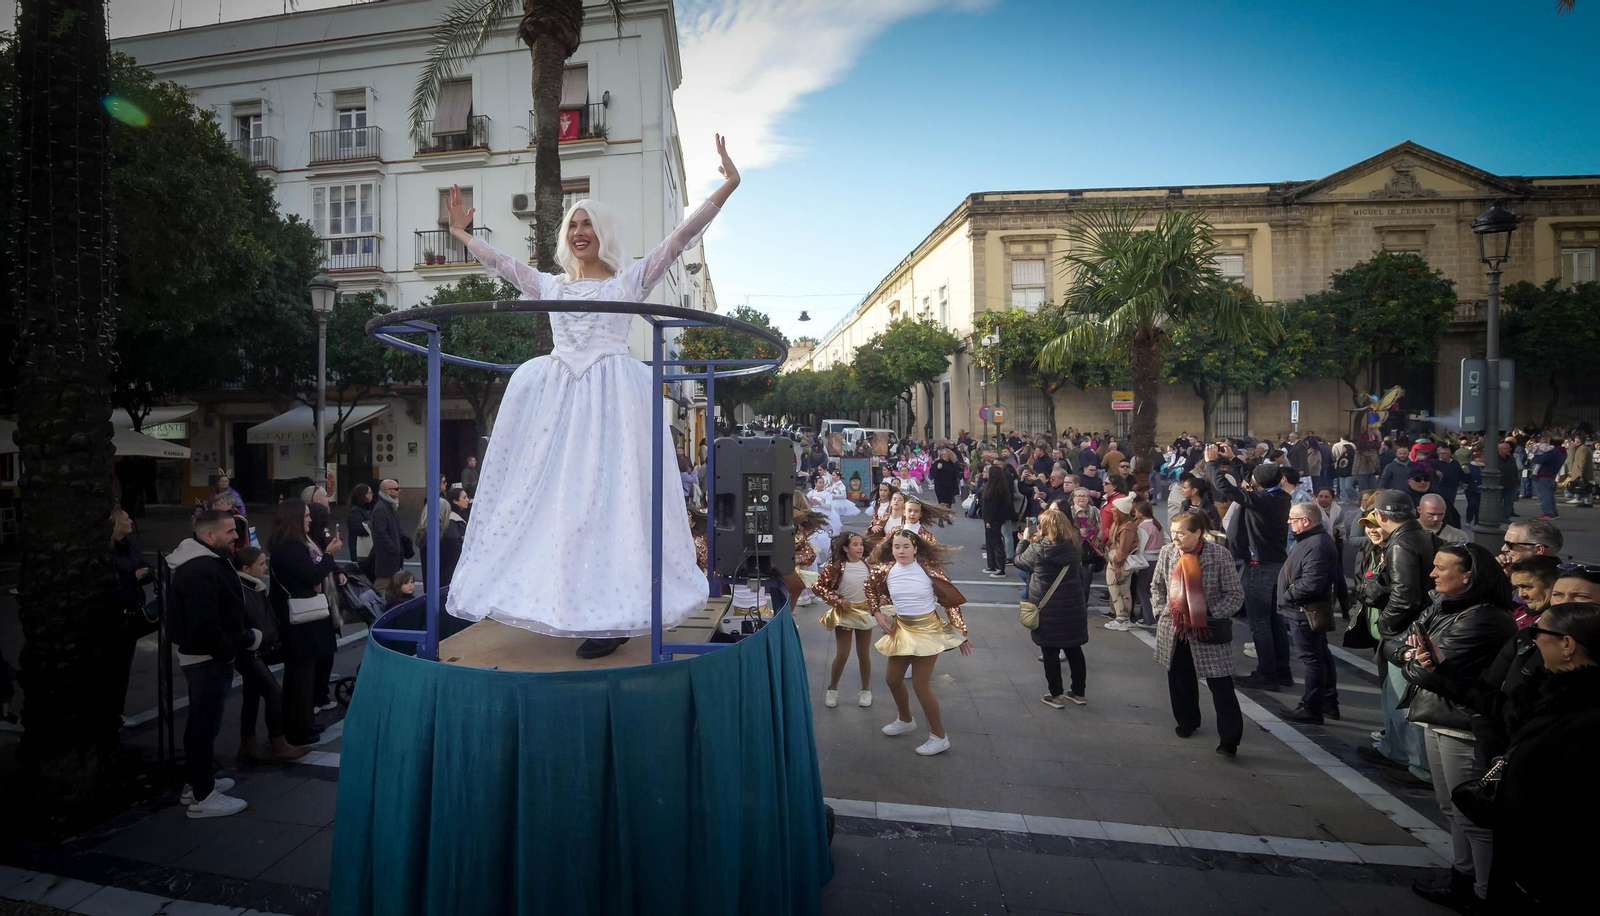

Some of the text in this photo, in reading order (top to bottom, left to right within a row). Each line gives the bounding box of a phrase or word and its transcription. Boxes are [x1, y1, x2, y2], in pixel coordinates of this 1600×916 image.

[1353, 208, 1384, 216] MIGUEL
[1400, 207, 1452, 215] CERVANTES
[302, 432, 316, 440] BA
